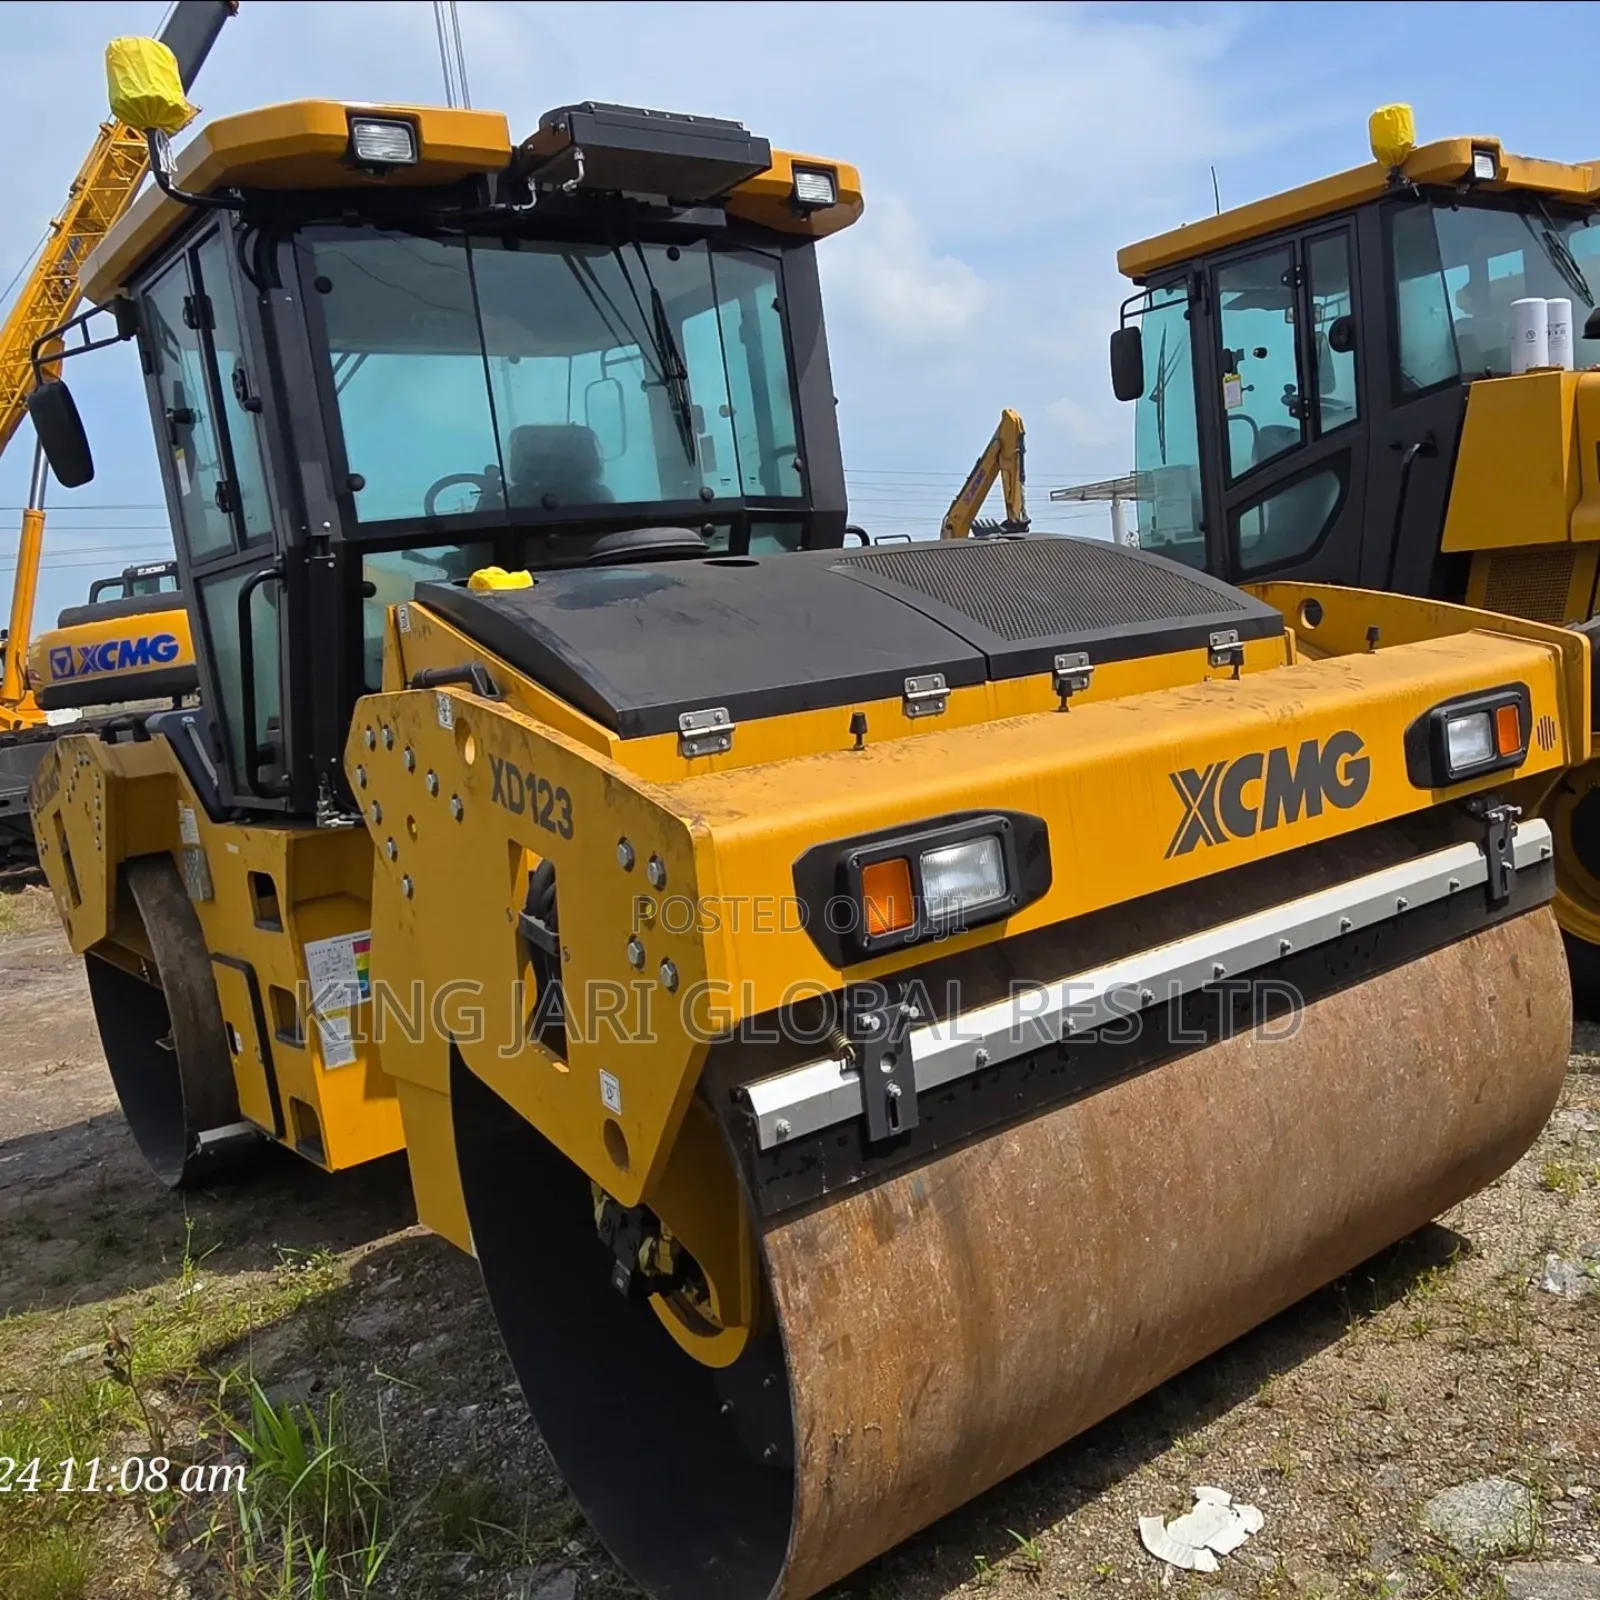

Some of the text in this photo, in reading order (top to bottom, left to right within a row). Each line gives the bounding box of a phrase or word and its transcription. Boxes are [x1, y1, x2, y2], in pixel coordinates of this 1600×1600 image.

[77, 634, 179, 675] XCMG
[488, 753, 574, 841] XD123
[1164, 730, 1371, 859] XCMG
